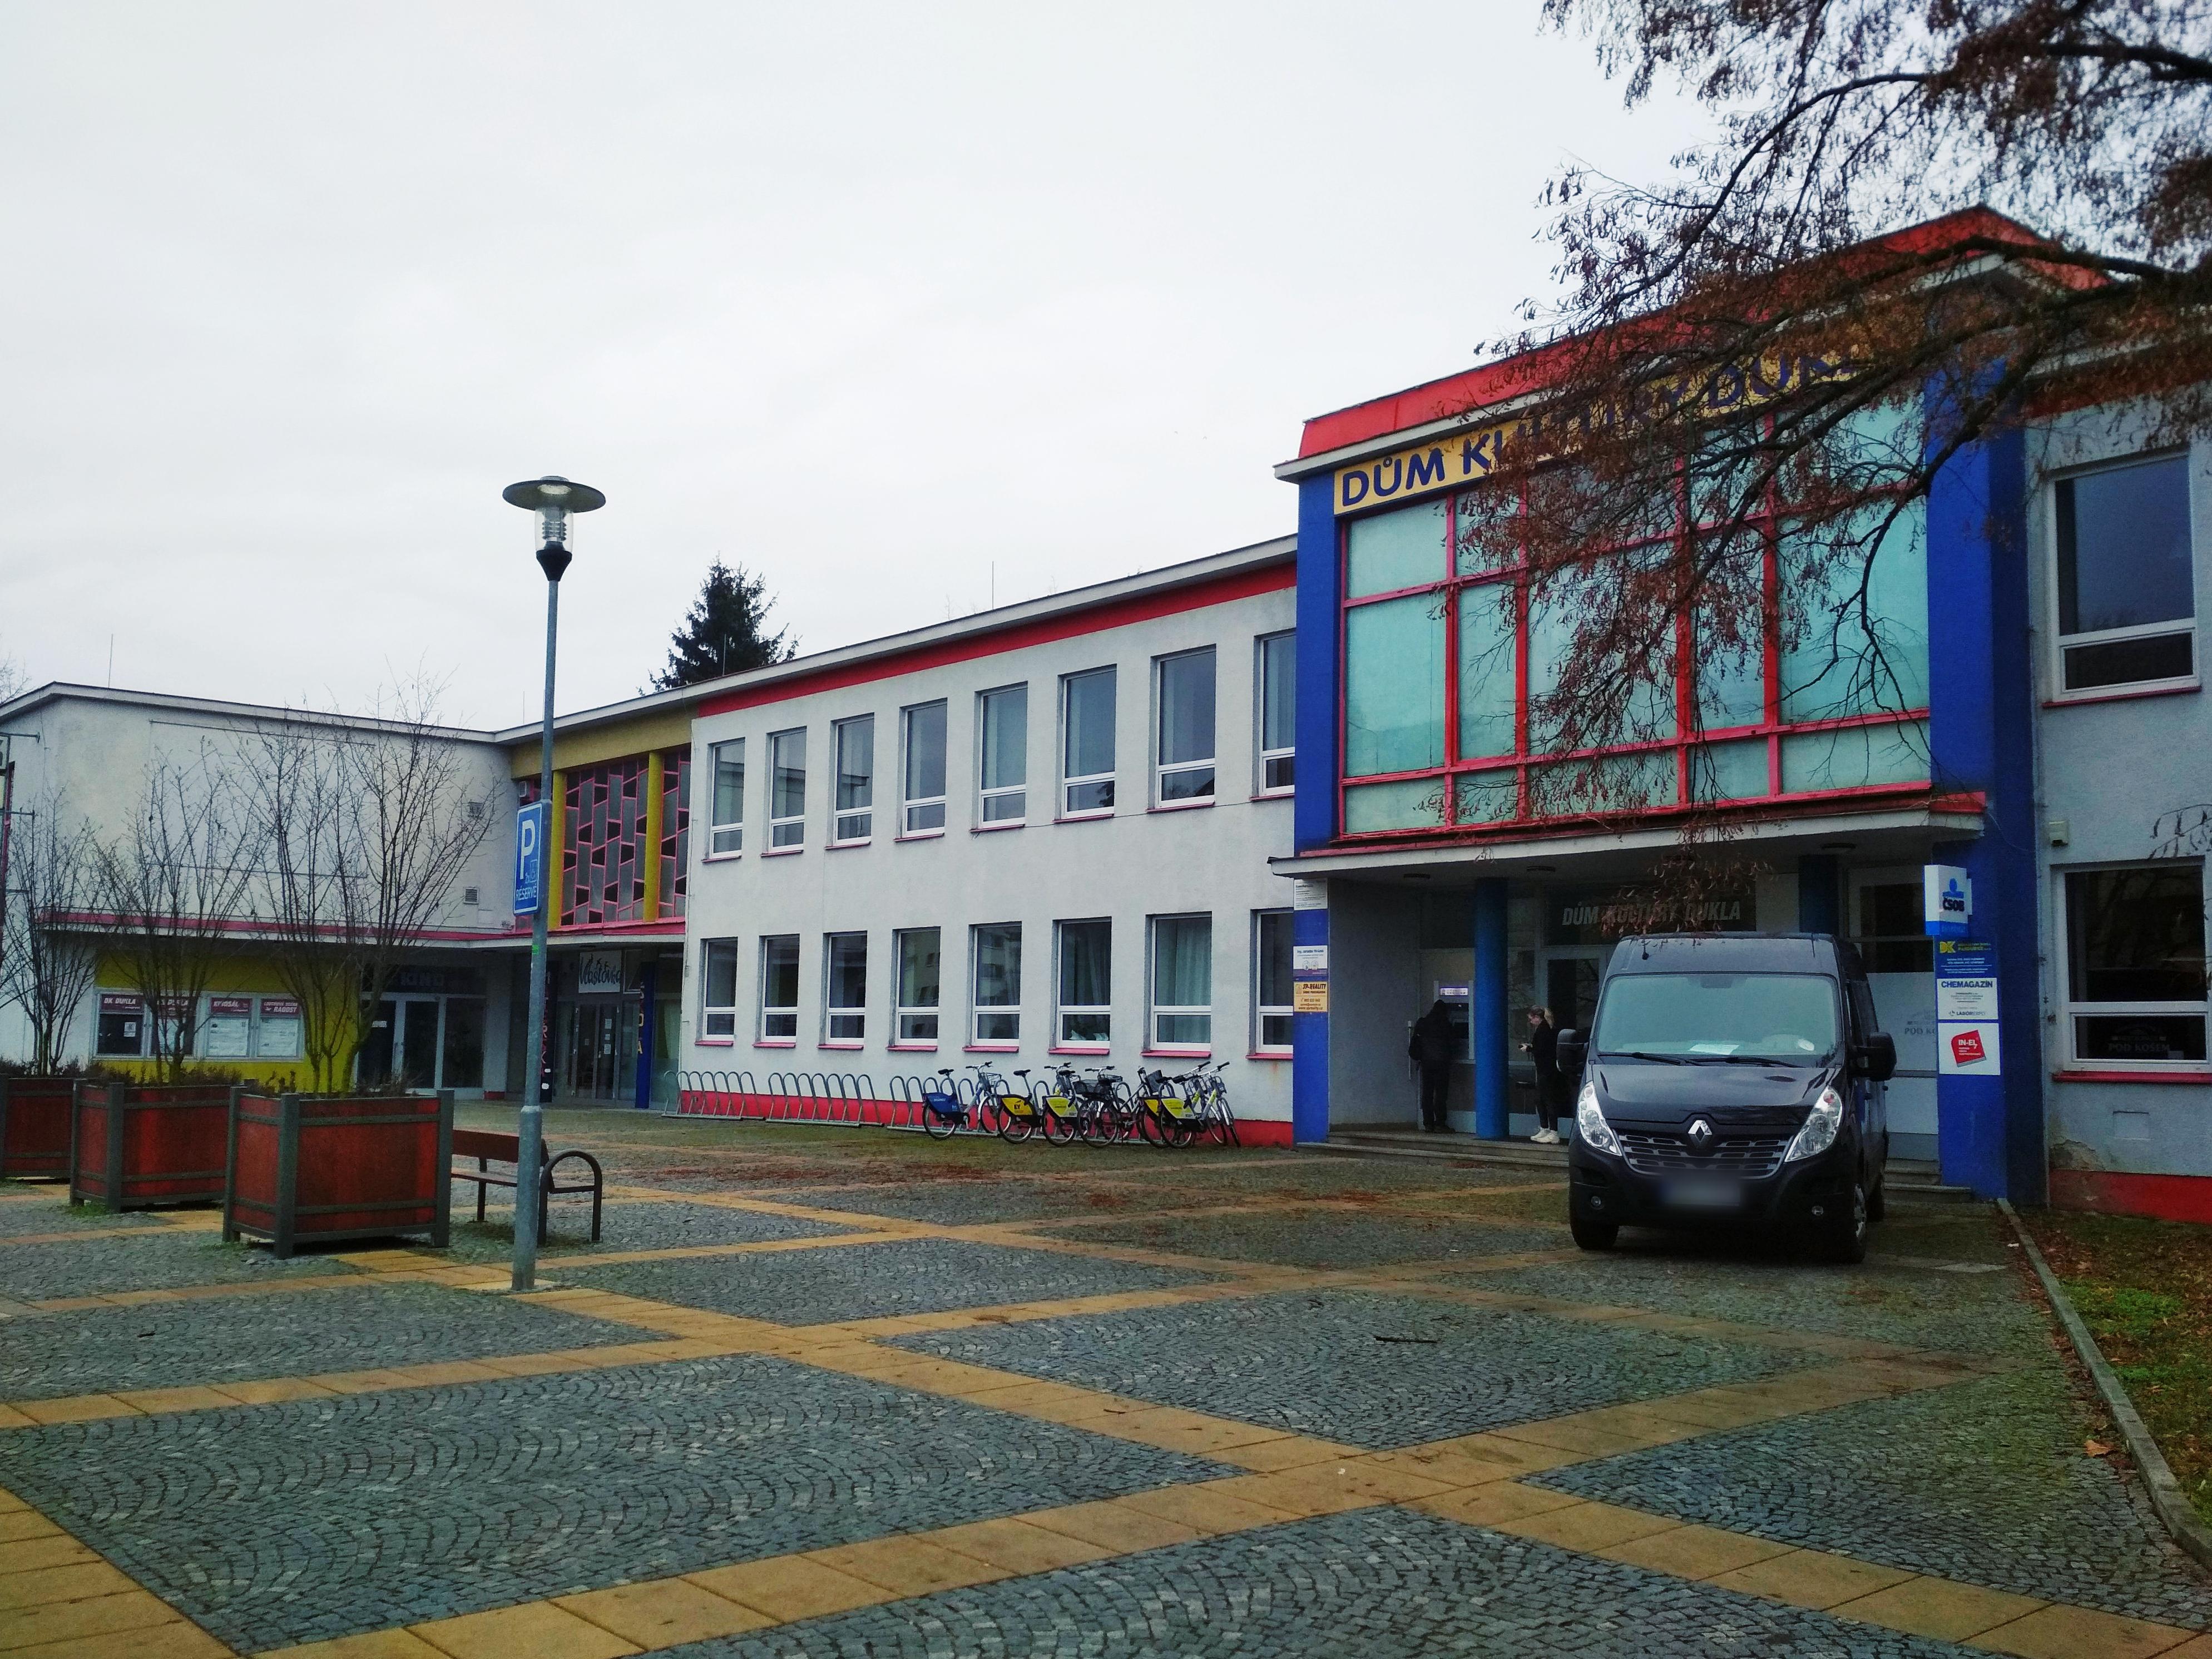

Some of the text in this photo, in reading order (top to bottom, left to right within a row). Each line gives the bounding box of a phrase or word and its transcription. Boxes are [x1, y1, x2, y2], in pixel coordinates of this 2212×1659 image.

[1342, 447, 1446, 507] DŮM
[521, 819, 535, 880] P
[516, 884, 537, 902] RÉSERVÉ
[1943, 897, 1964, 912] ČSOB
[1561, 900, 1599, 925] DŮM
